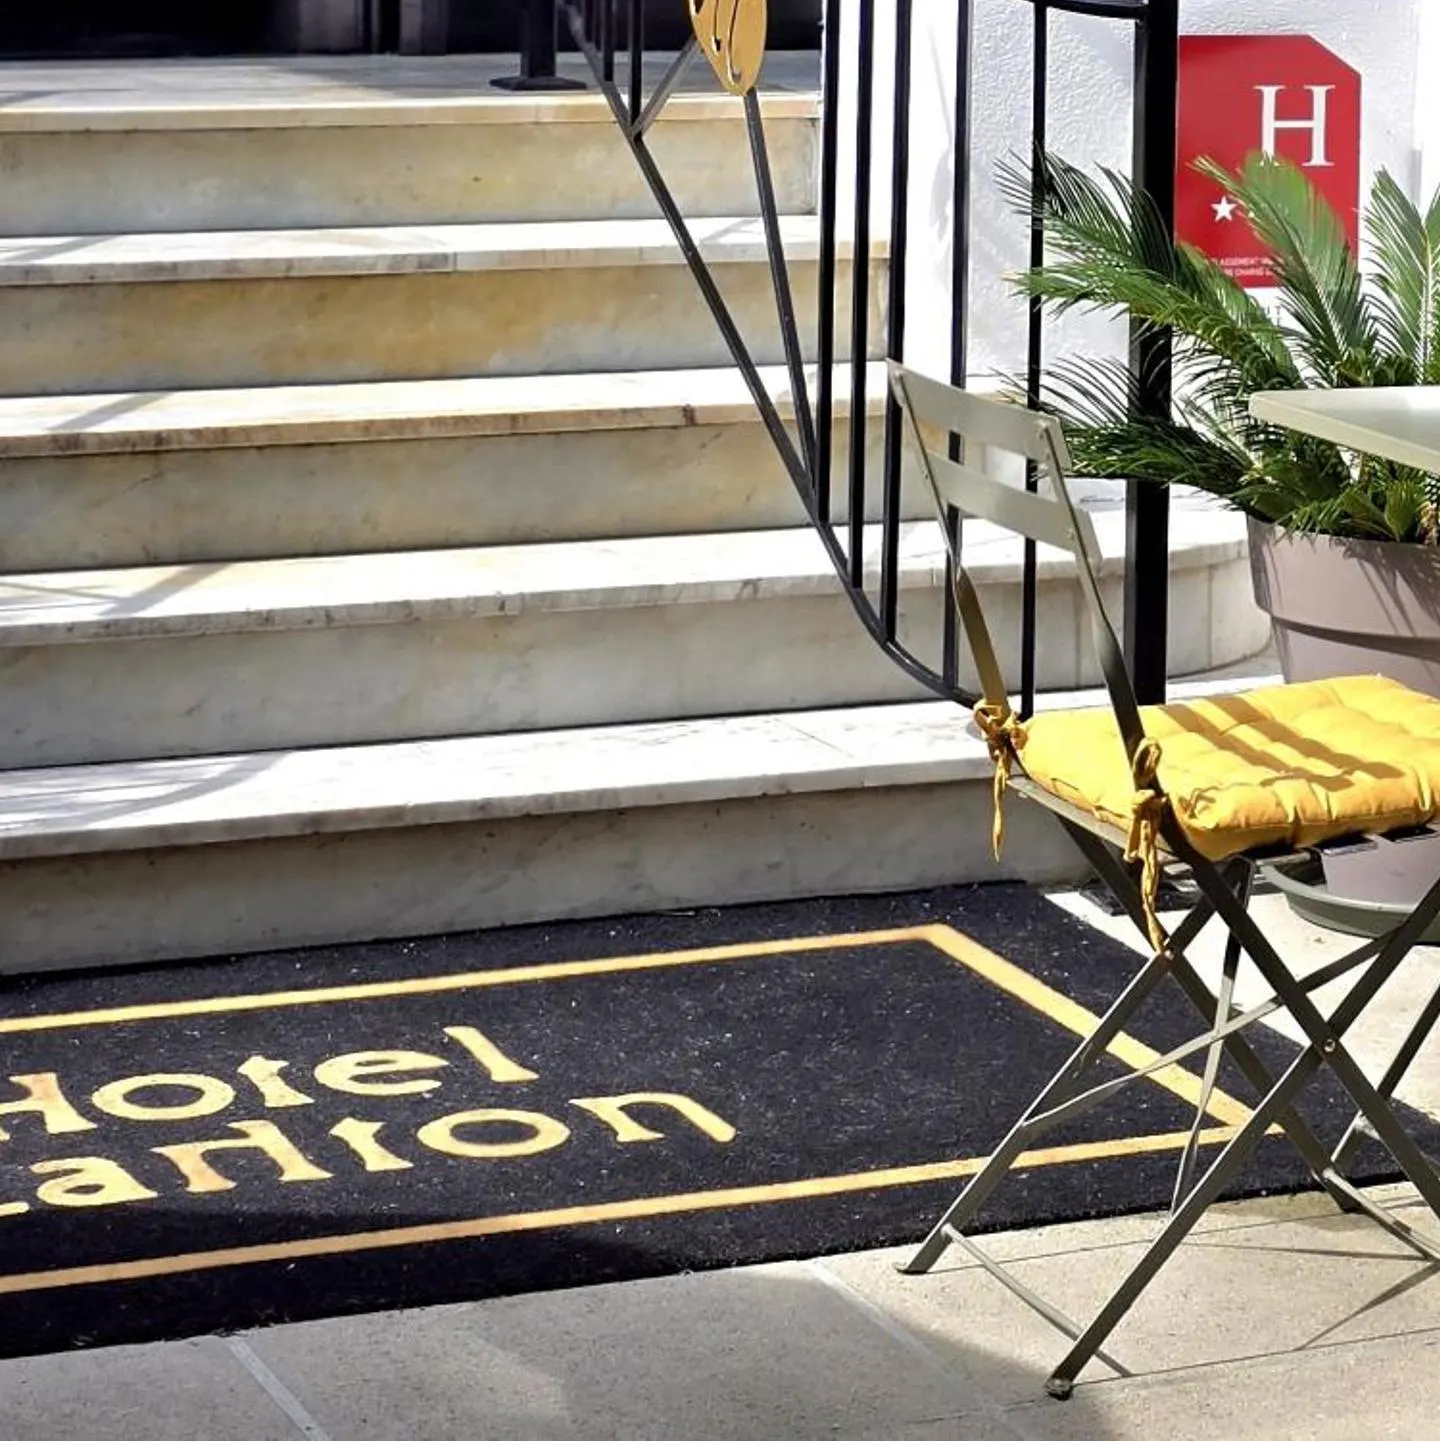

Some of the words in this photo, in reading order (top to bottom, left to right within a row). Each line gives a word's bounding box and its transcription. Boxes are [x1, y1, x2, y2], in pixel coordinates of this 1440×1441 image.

[1253, 83, 1336, 167] H
[0, 1026, 538, 1142] Hotel
[0, 1091, 738, 1218] arlton
